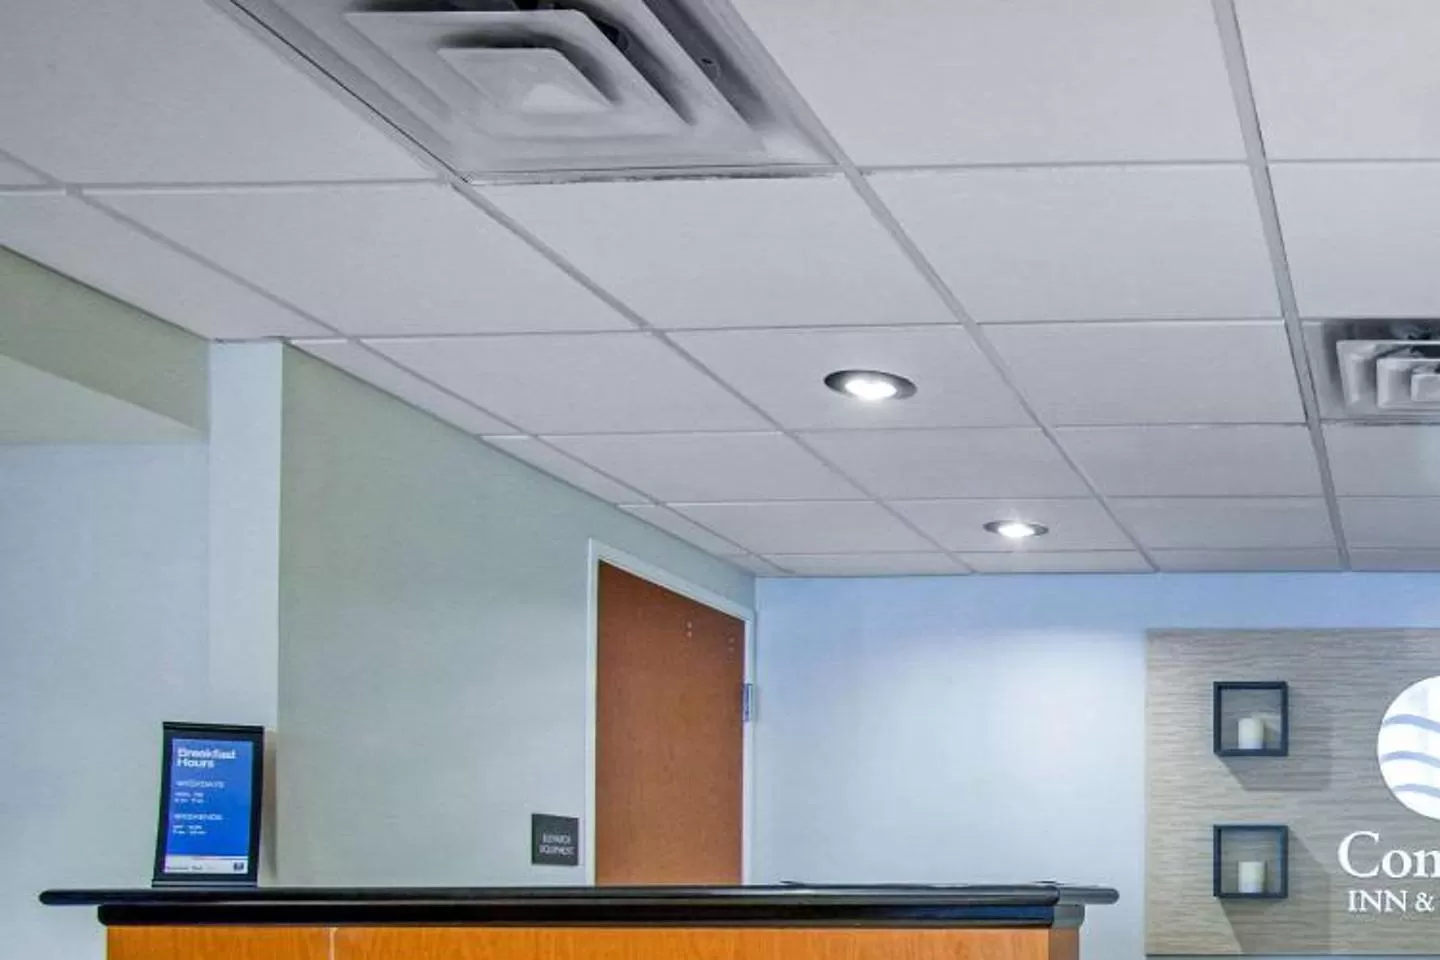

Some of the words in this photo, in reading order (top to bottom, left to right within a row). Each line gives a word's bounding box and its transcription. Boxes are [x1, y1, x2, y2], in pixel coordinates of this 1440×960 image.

[177, 747, 237, 760] Breakfast
[176, 758, 215, 769] Hours
[1347, 890, 1408, 913] INN
[1414, 891, 1435, 913] &
